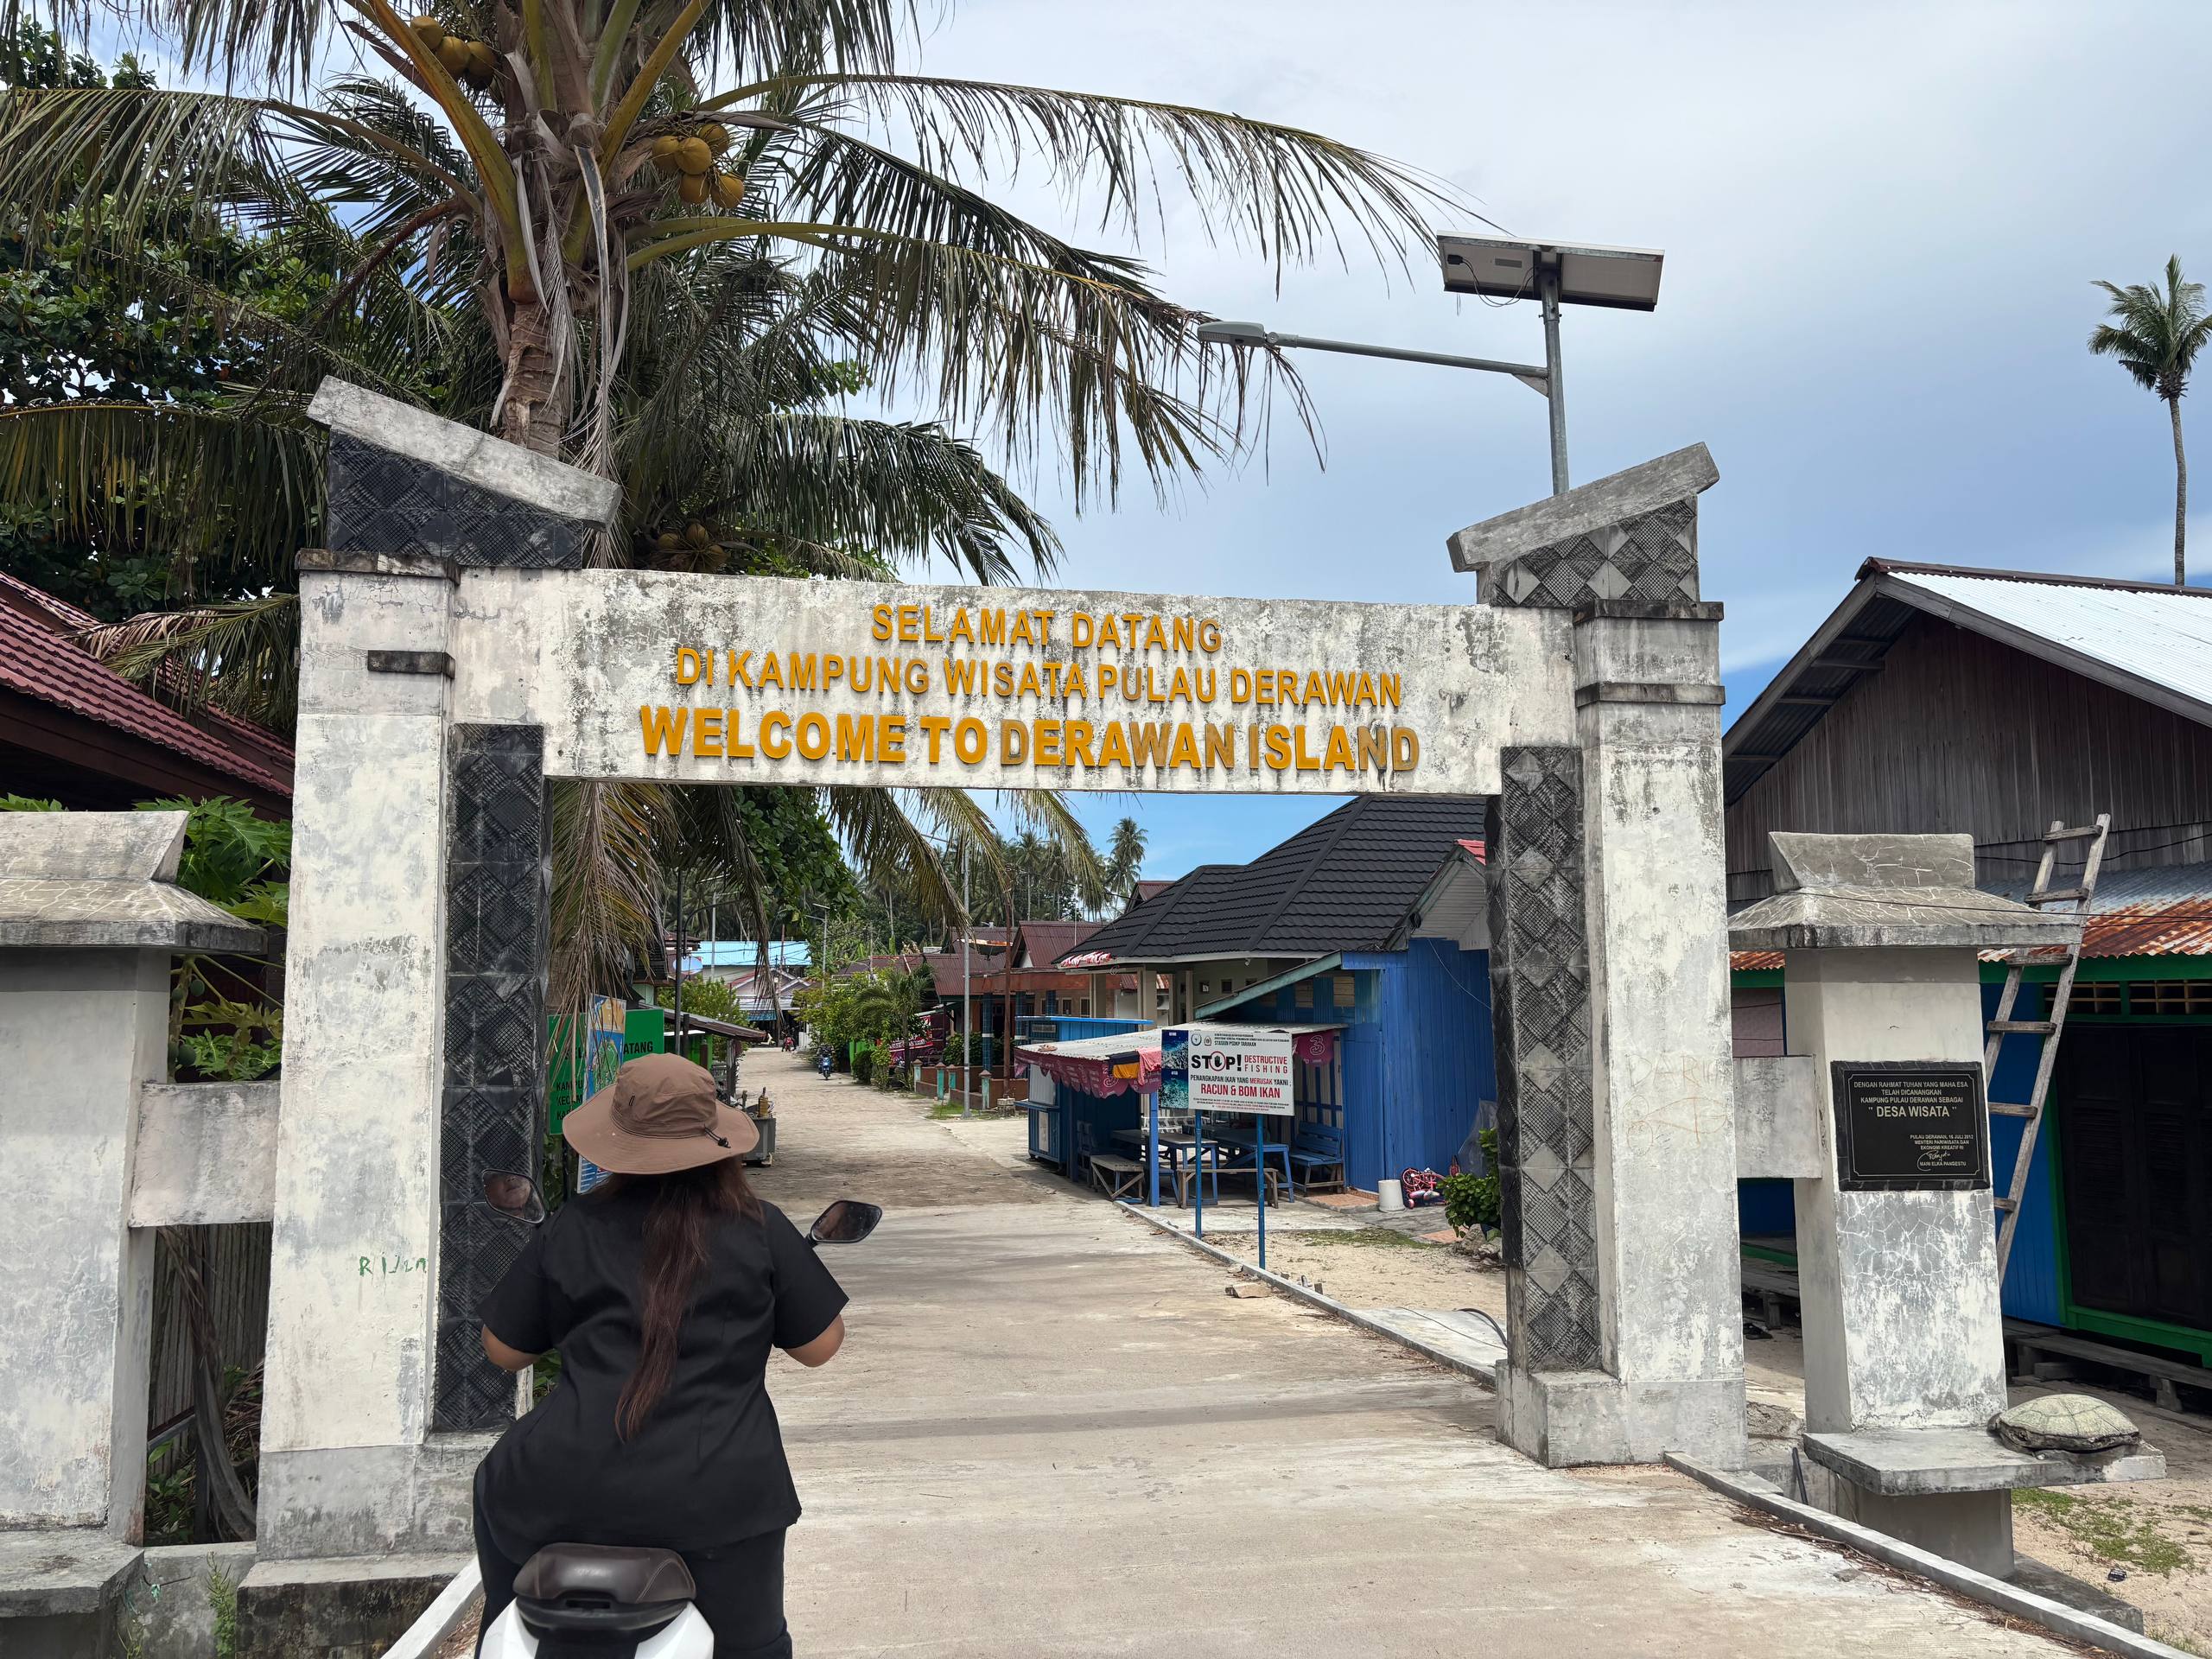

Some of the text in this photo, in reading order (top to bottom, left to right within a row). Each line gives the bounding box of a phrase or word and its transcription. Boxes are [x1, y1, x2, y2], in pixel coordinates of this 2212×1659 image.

[872, 604, 1222, 652] SELAMAT DATANG
[677, 647, 1401, 707] DI KAMPUNG WISATA PULAU DERAWAN
[640, 705, 1420, 772] WELCOME TO DERAWAN ISLAND
[622, 1041, 653, 1054] ATANG
[1244, 1055, 1287, 1065] DESTRUCTIVE
[1244, 1065, 1287, 1074] FISHING
[1201, 1084, 1281, 1098] RACUN & BOM IKAN
[1876, 1106, 1907, 1117] DESA
[1908, 1106, 1950, 1117] WISATA
